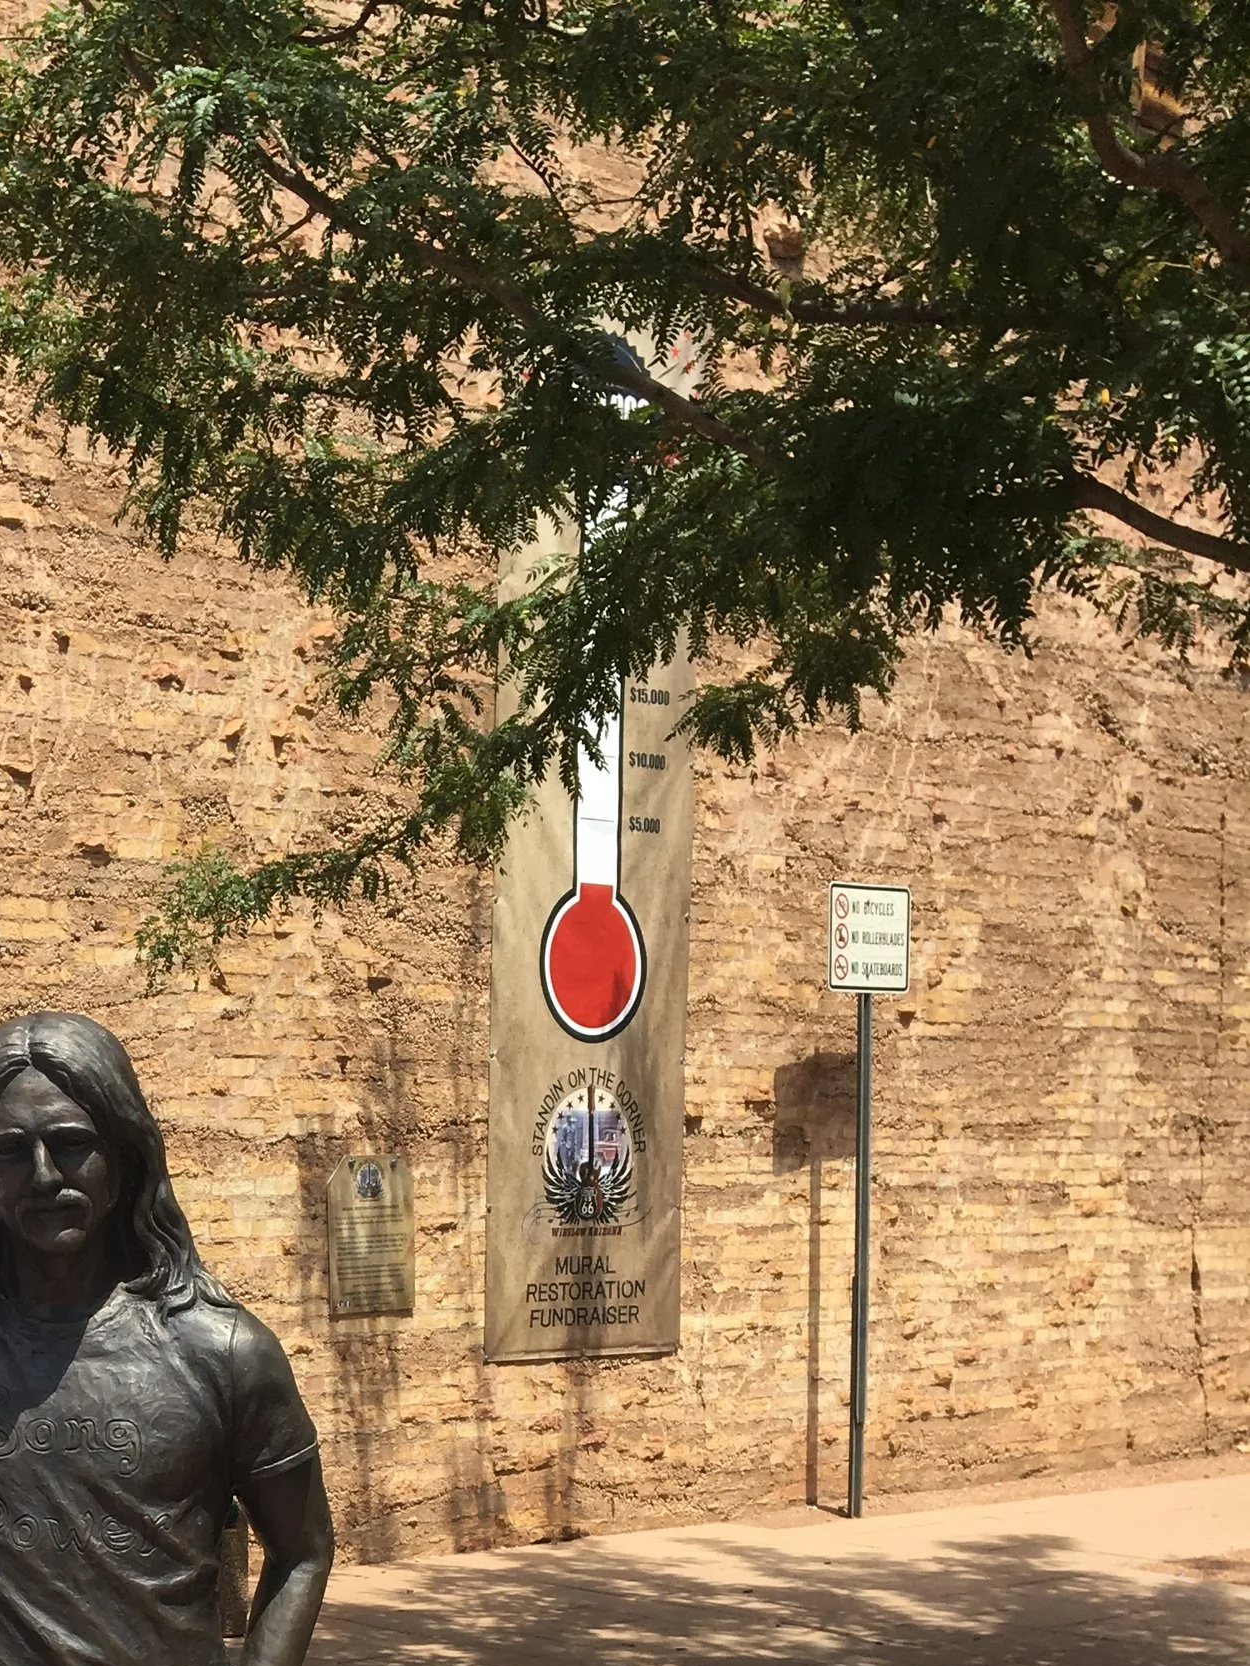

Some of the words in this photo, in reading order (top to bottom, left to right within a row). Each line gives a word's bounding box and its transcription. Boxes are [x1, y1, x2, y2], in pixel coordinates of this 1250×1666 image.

[630, 687, 670, 707] $15,000
[629, 750, 667, 771] $10,000
[628, 815, 661, 835] $5,000
[852, 900, 860, 914] NO
[863, 901, 894, 916] BICYCLES
[851, 931, 859, 944] NO
[851, 962, 859, 974] NO
[862, 963, 903, 977] SKATEBOARDS
[568, 1068, 588, 1087] ON
[589, 1067, 615, 1090] THE
[616, 1080, 647, 1155] CORNER
[581, 1203, 595, 1215] 66
[555, 1255, 616, 1276] MURAL
[526, 1279, 647, 1304] RESTORATION
[529, 1304, 641, 1329] FUNDRAISER
